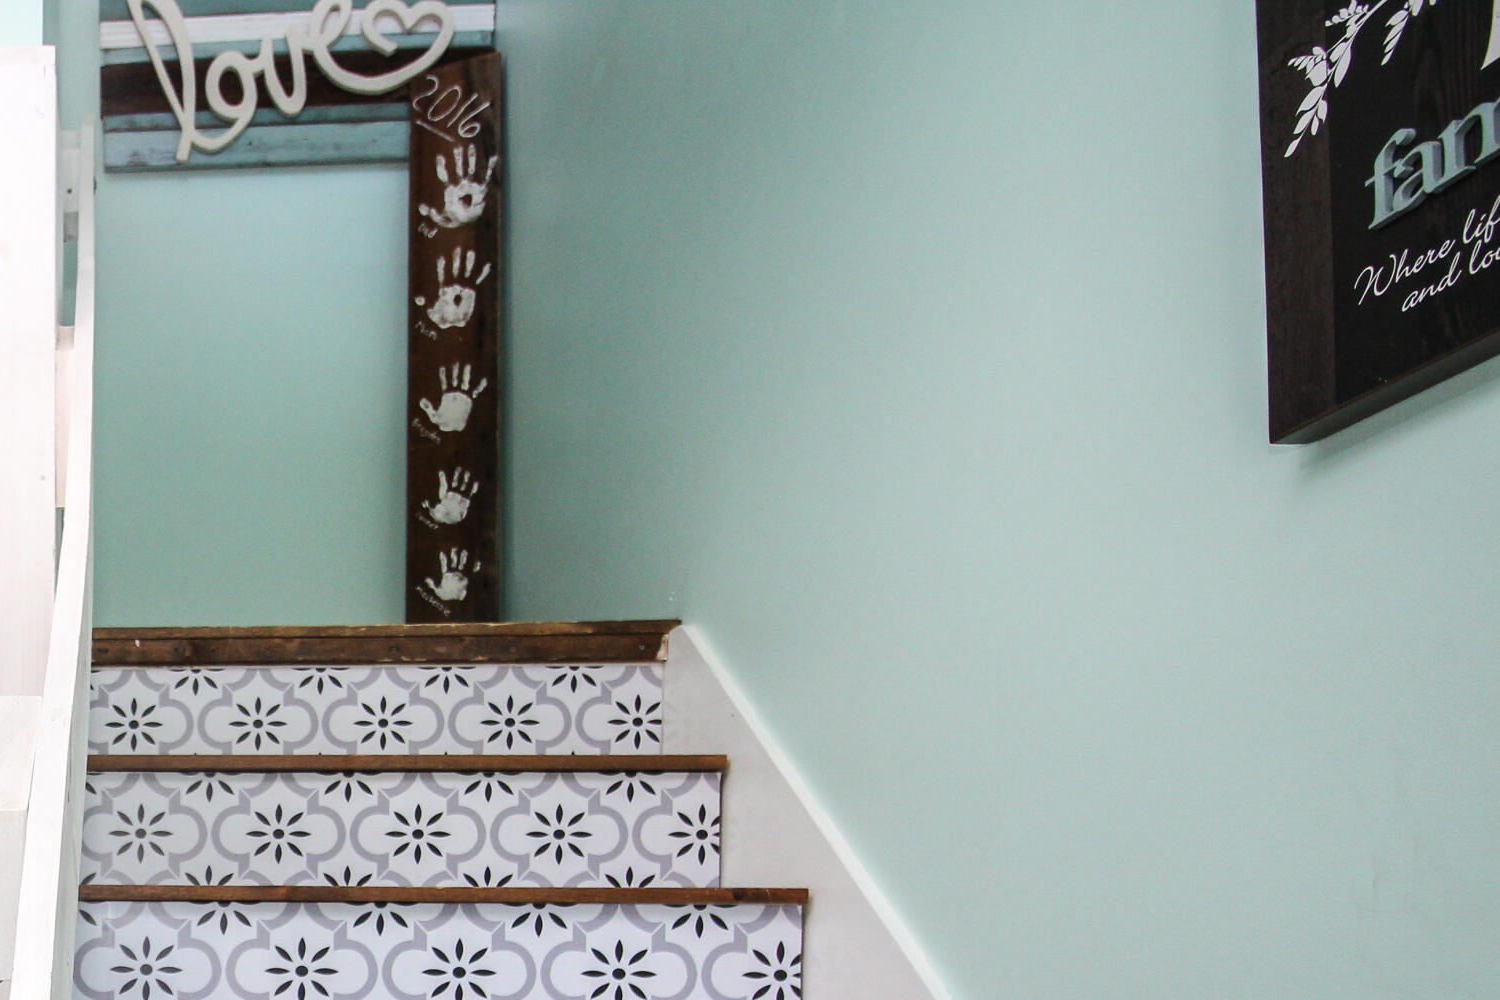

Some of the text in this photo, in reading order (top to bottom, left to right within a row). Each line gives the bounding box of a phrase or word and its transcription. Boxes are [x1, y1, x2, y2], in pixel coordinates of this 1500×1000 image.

[412, 74, 491, 138] 2016
[1353, 238, 1456, 306] Where
[1401, 251, 1463, 313] and
